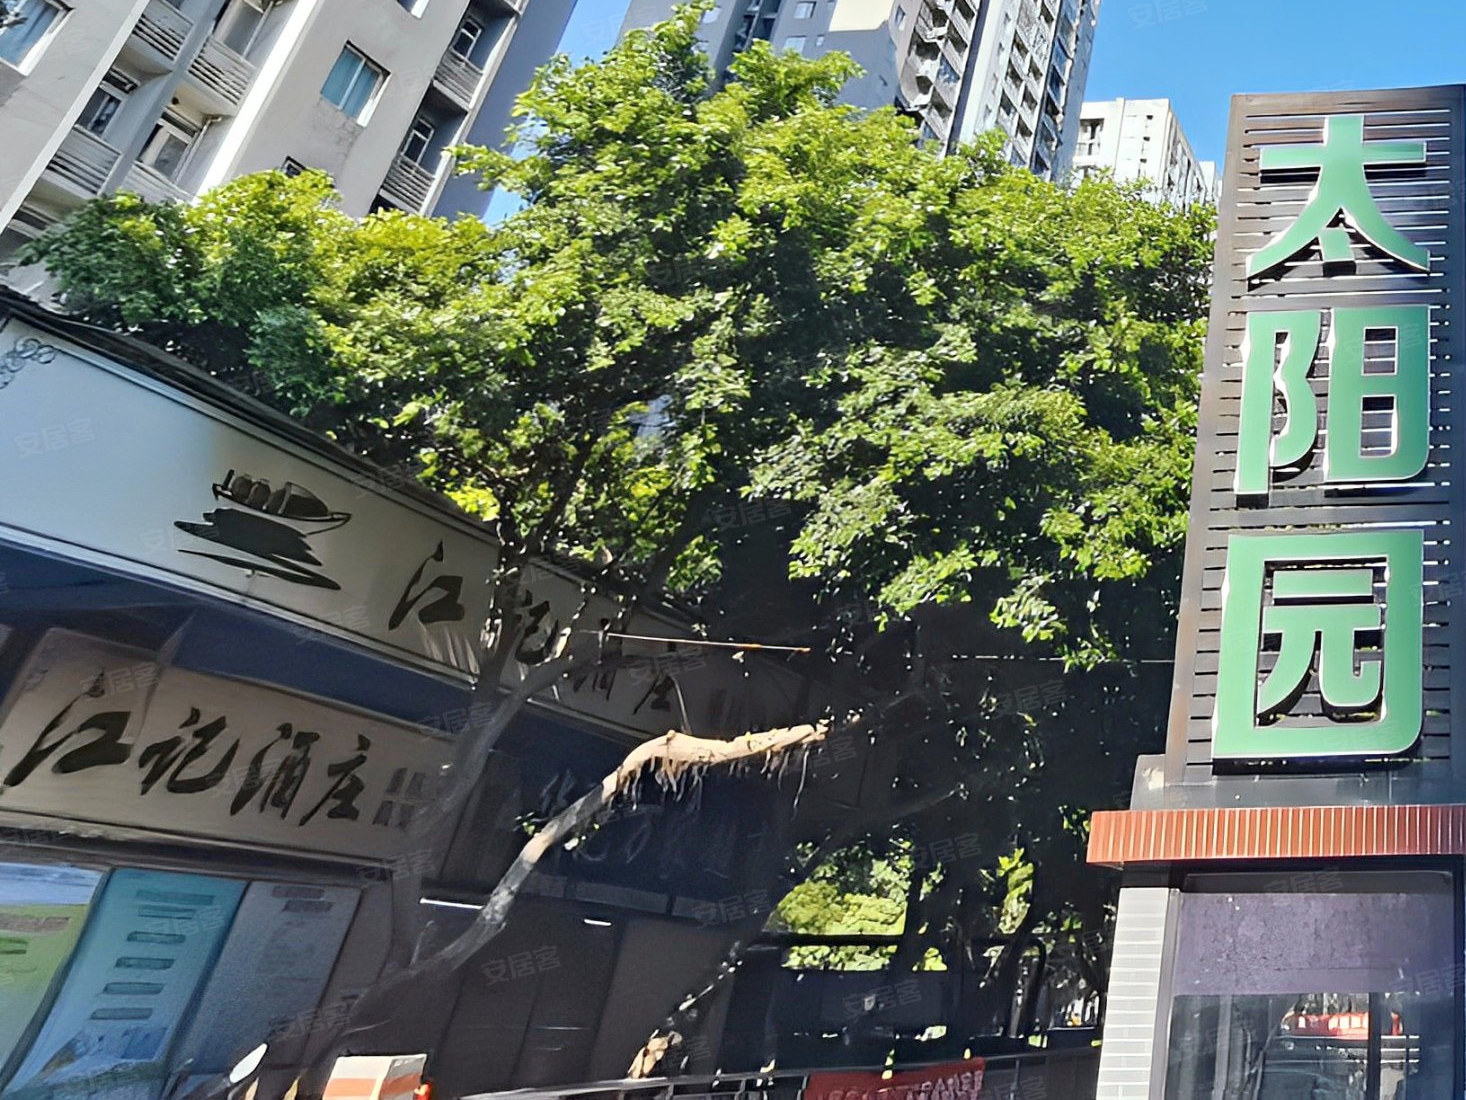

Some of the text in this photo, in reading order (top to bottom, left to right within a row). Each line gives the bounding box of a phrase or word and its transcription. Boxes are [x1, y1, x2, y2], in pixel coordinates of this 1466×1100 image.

[1212, 115, 1431, 762] 太阳园
[3, 669, 371, 827] 江记酒庄
